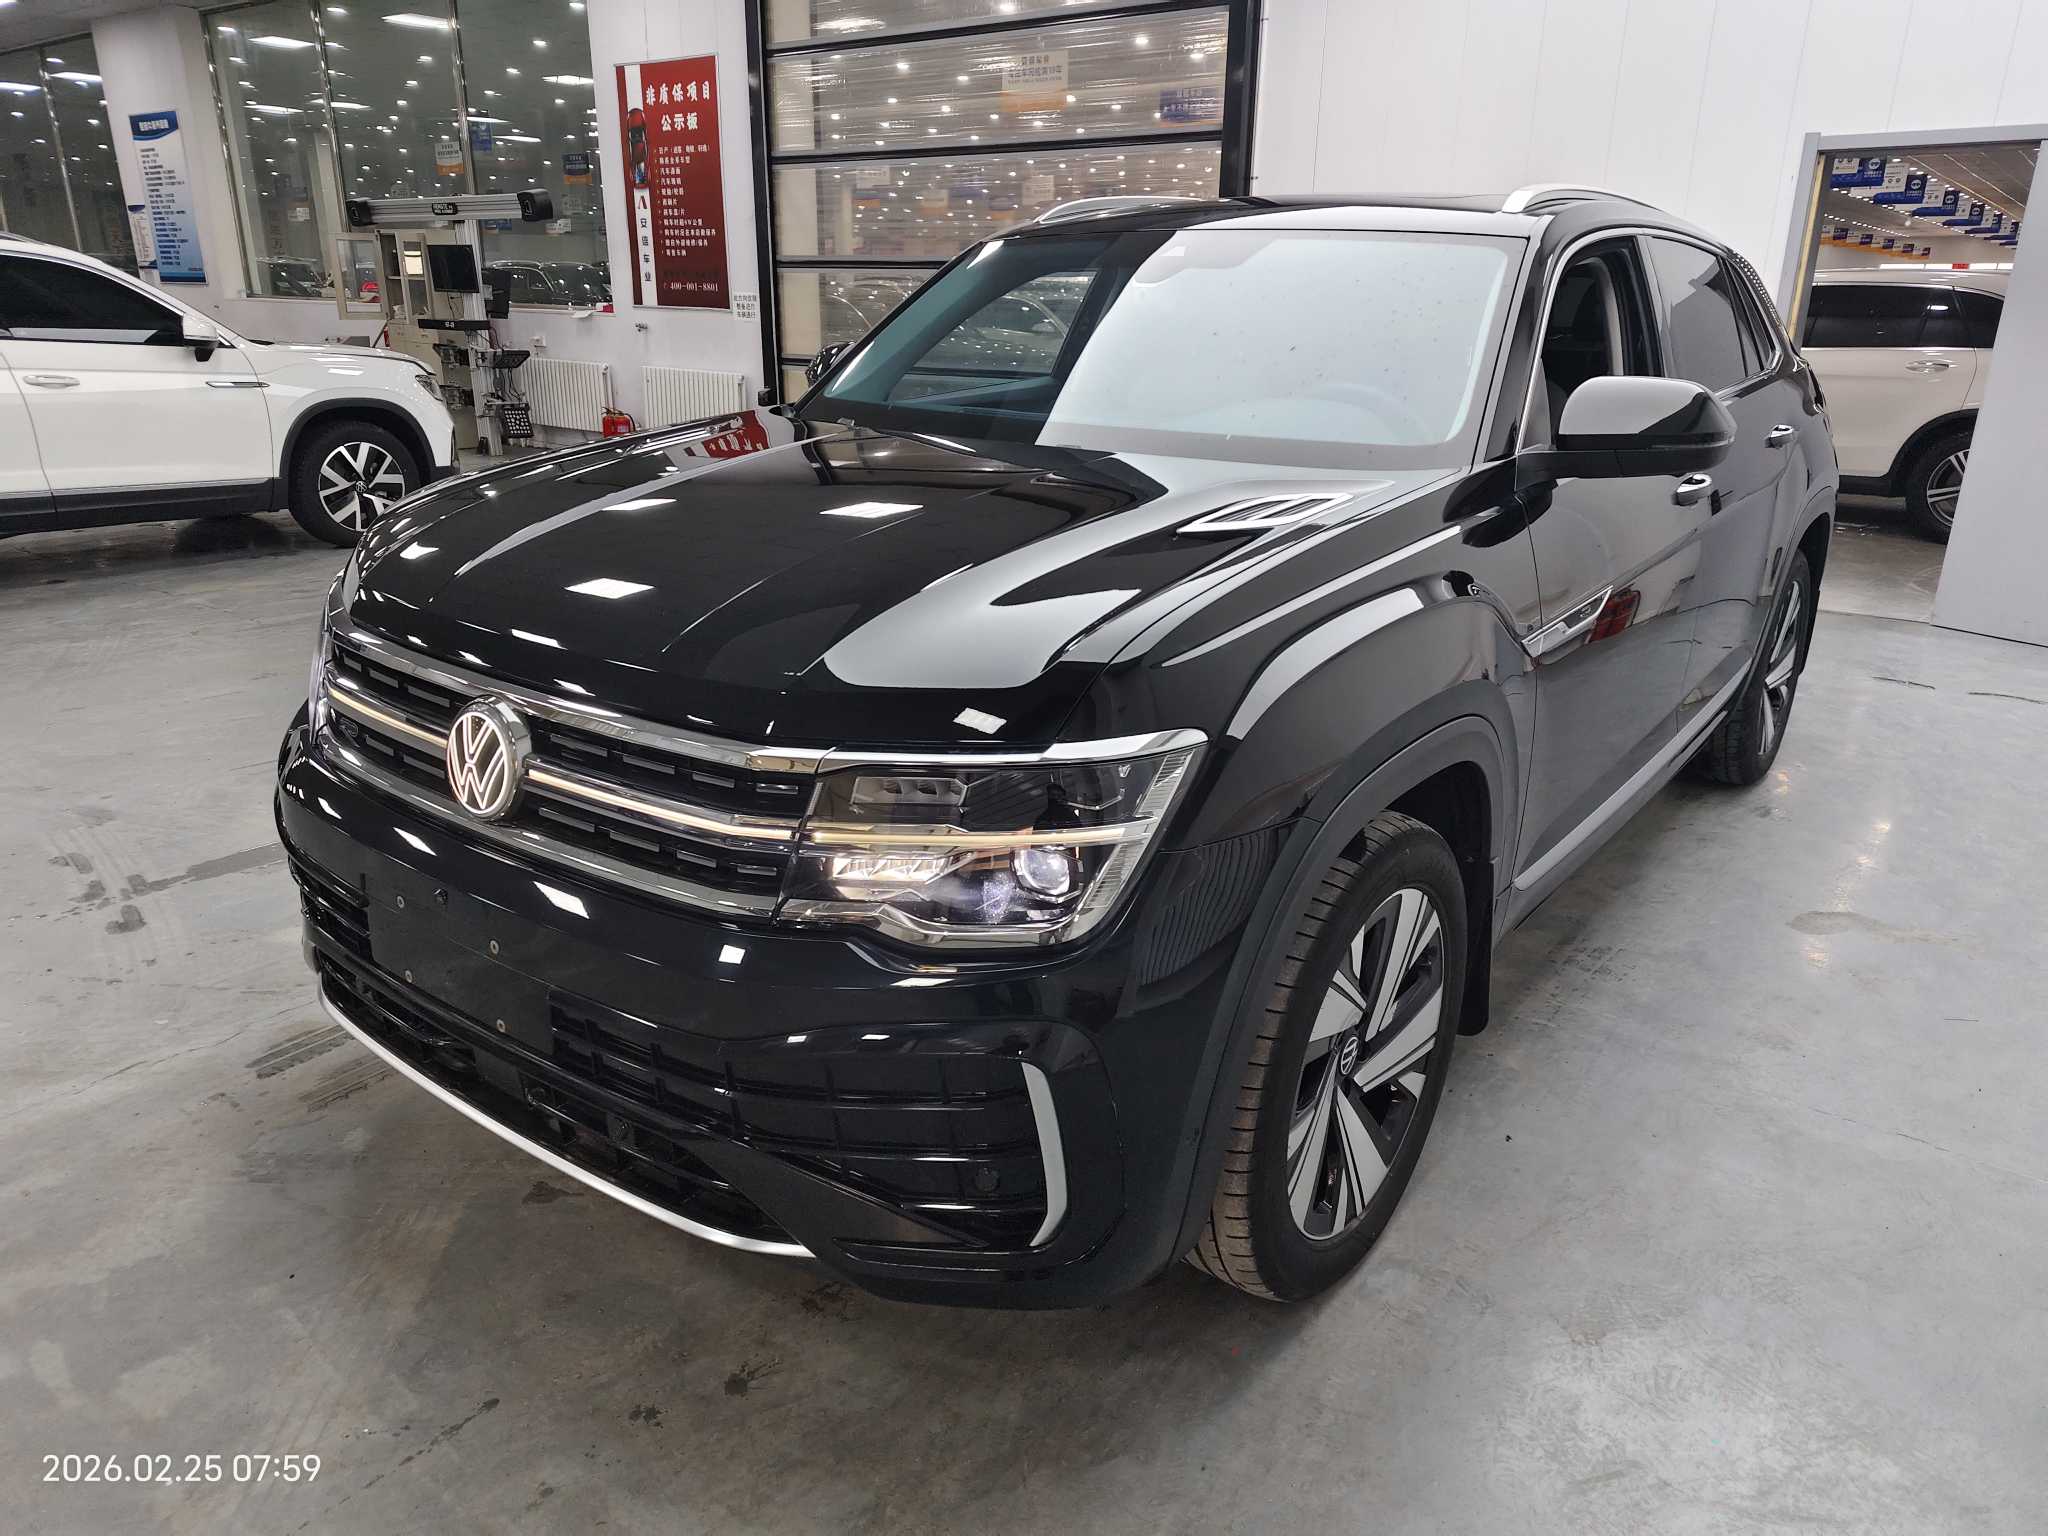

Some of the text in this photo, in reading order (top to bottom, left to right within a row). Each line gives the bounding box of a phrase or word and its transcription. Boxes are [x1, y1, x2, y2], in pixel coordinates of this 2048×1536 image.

[646, 81, 710, 107] 非质保项目
[661, 112, 698, 132] 公示板
